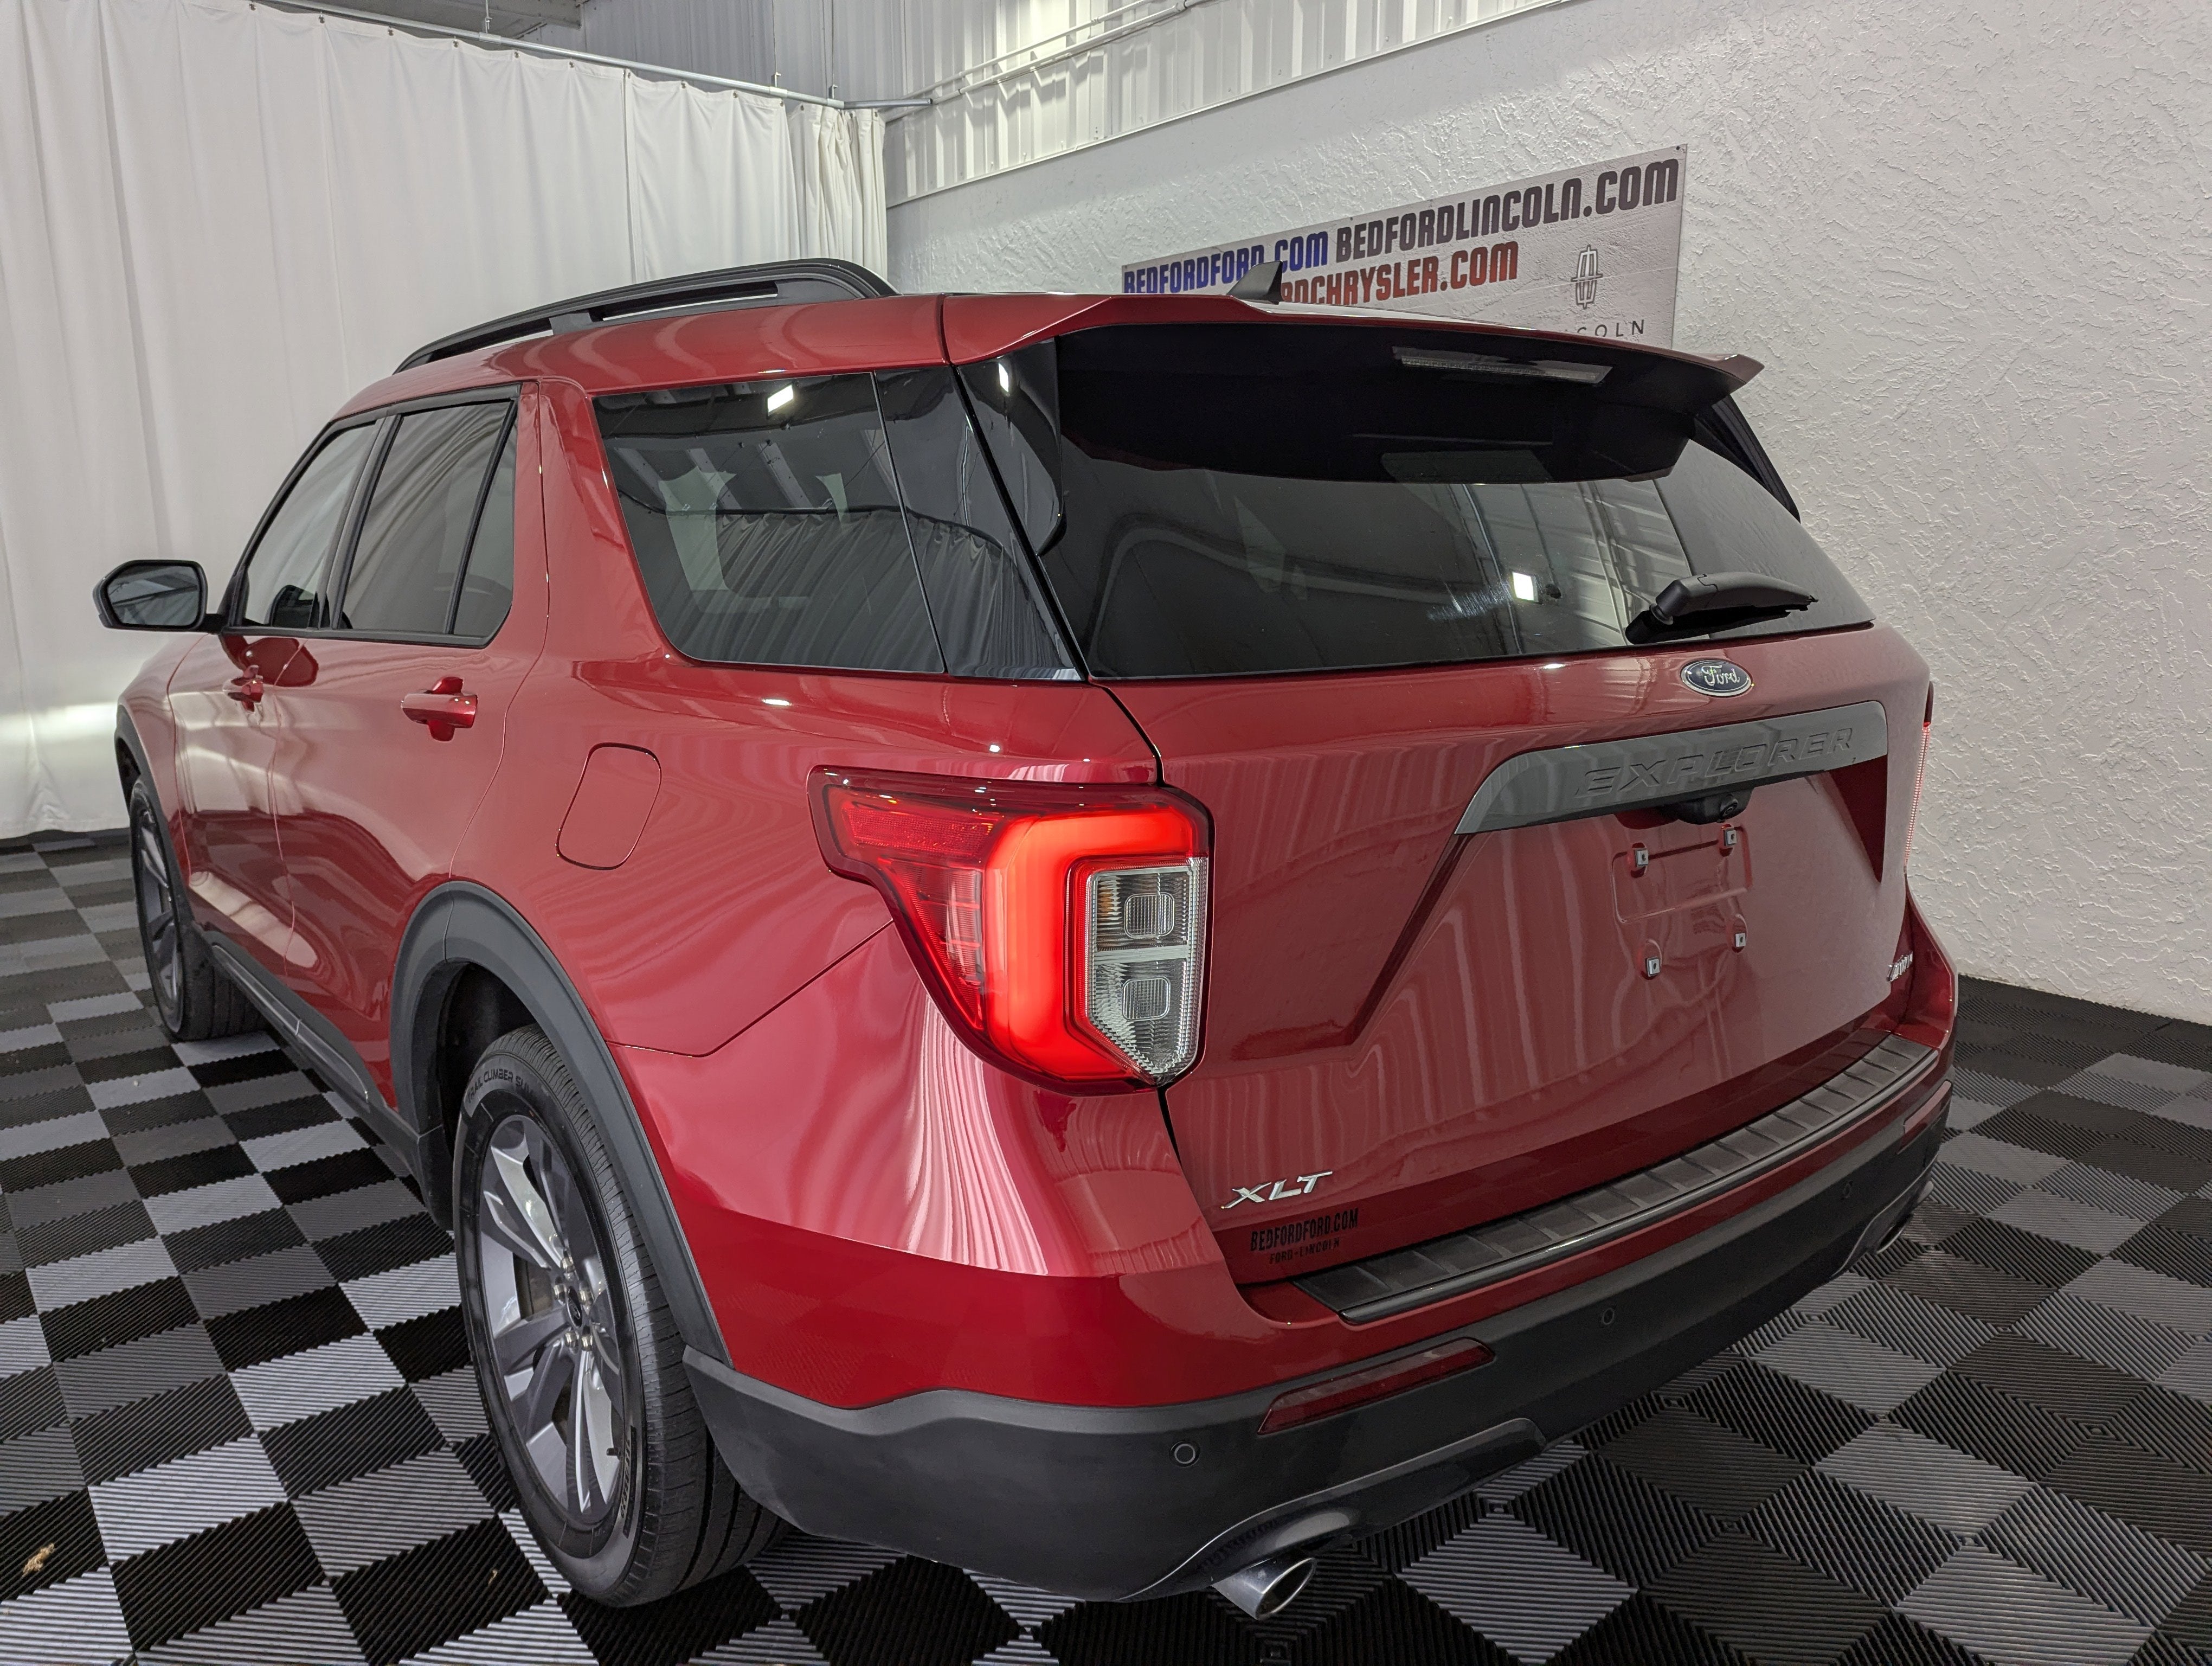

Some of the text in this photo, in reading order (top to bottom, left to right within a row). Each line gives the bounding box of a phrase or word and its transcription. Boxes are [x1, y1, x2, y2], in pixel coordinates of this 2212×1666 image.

[1124, 159, 1679, 293] BEDFORDFORDCOM BEDFORDLINCOLN.COM
[1701, 665, 1740, 687] Ford
[1575, 727, 1853, 798] EXPLORER
[484, 1068, 513, 1082] CLIMBER
[1220, 1171, 1333, 1209] XLT
[1250, 1208, 1359, 1251] BEDFORDFORD.COM
